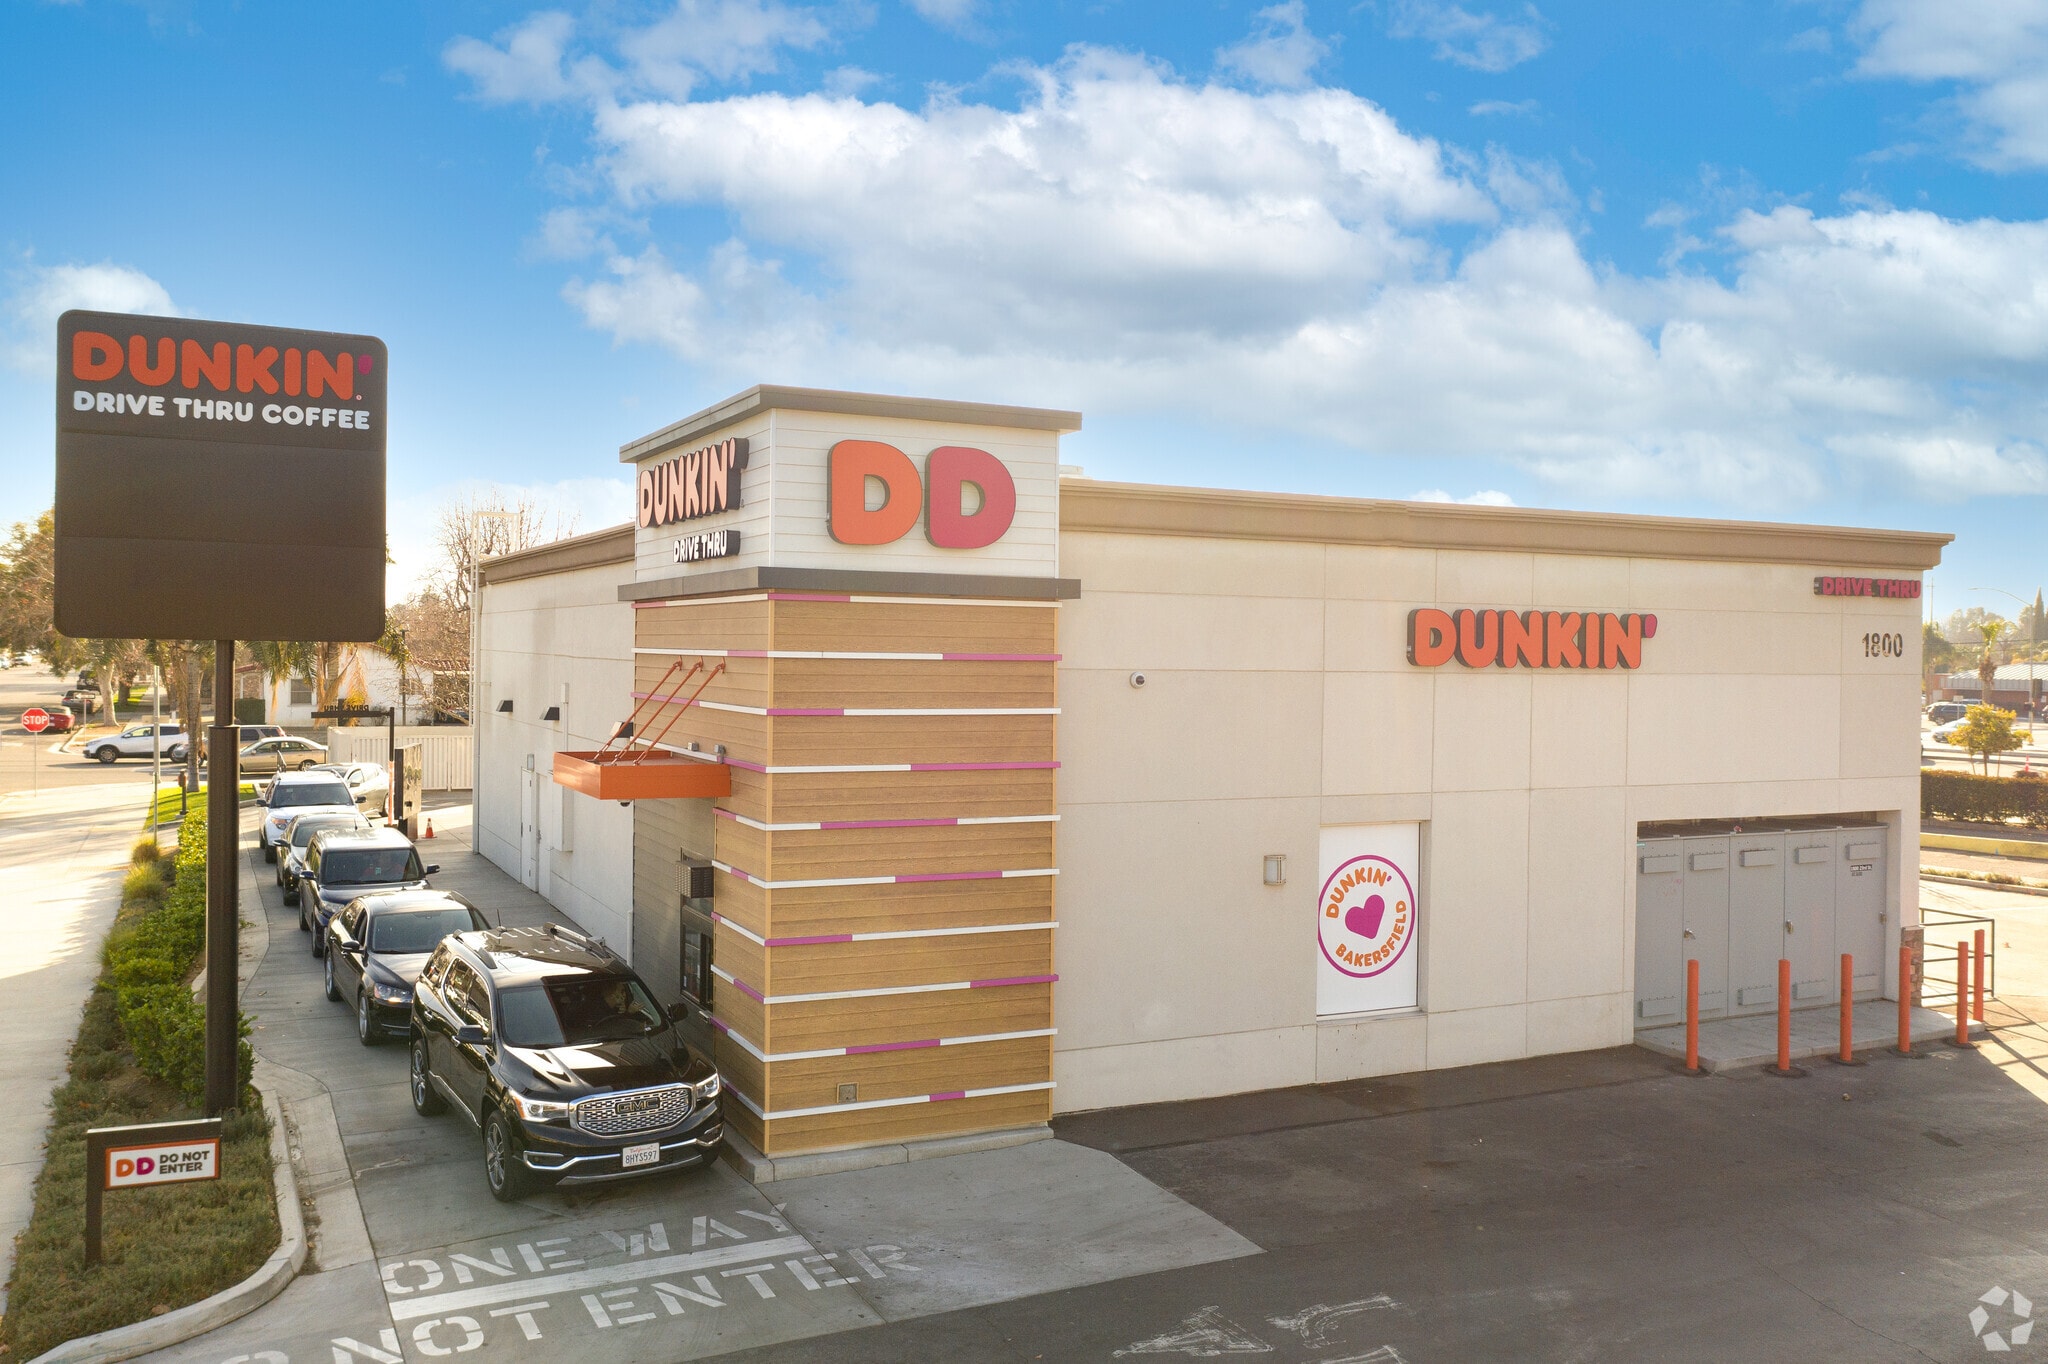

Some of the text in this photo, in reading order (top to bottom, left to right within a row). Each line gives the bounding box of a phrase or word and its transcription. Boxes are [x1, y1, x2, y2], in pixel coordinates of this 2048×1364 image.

[72, 331, 373, 400] DUNKIN'
[73, 390, 370, 430] DRIVE THRU COFFEE
[640, 437, 737, 529] DUNKIN'
[828, 440, 1016, 549] DD
[673, 530, 728, 563] DRIVE THRU
[1822, 576, 1921, 599] DRIVE THRU
[1412, 608, 1658, 669] DUNKIN'
[1862, 632, 1903, 658] 1800
[23, 715, 48, 725] STOP
[1325, 866, 1392, 919] DUNKIN'
[1335, 900, 1407, 967] BAKERSFIELD
[617, 1097, 660, 1114] GMC
[115, 1156, 155, 1178] DD
[159, 1161, 203, 1175] ENTER
[160, 1150, 210, 1165] DO NOT
[381, 1202, 788, 1295] ONE WAY
[331, 1244, 922, 1364] NOT ENTER
